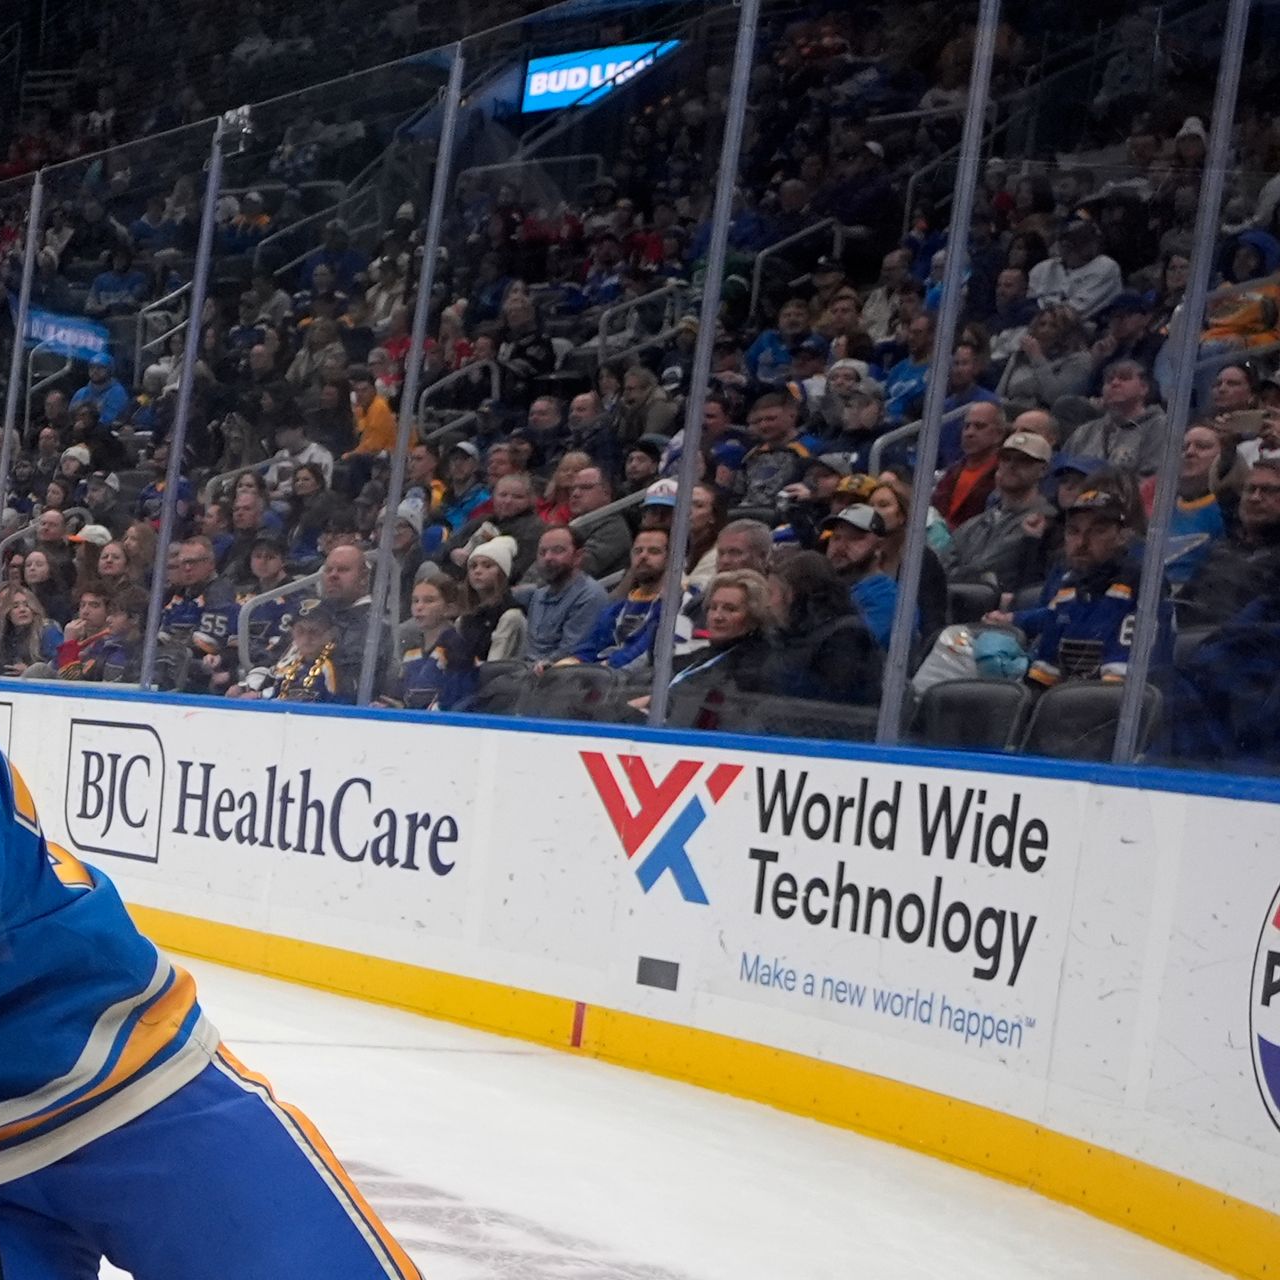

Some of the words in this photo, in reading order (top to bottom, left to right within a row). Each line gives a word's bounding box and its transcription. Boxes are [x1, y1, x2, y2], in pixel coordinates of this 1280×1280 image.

[529, 66, 589, 96] BUD
[77, 750, 151, 838] BJC
[172, 760, 459, 876] HealthCare
[756, 767, 902, 851] World
[919, 783, 1049, 873] Wide
[749, 848, 1038, 987] Technology
[740, 952, 797, 993] Make
[802, 972, 815, 996] a
[821, 975, 867, 1009] new
[872, 987, 935, 1025] world
